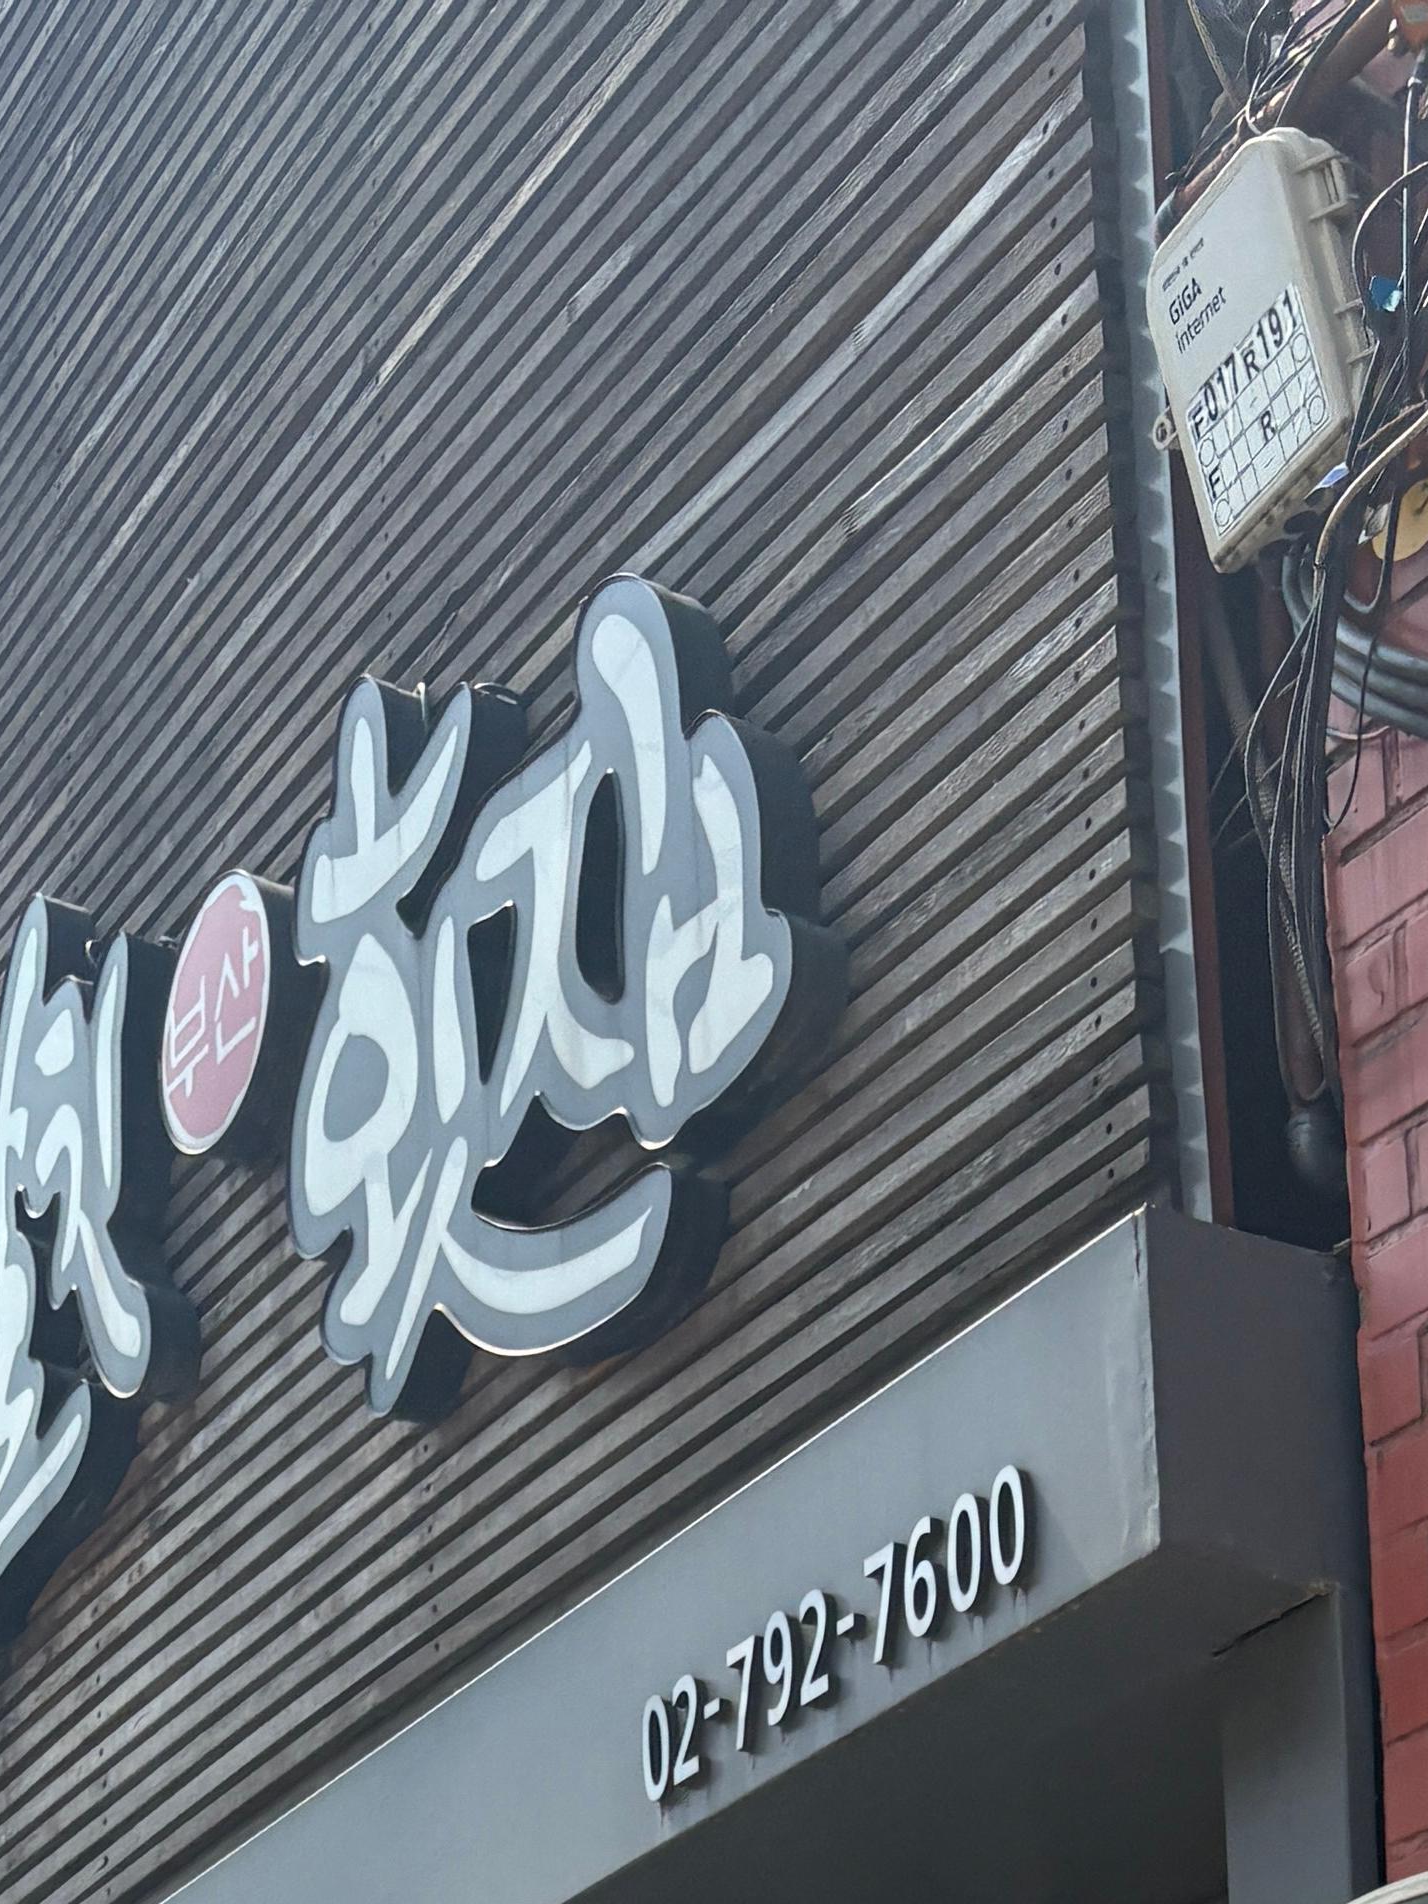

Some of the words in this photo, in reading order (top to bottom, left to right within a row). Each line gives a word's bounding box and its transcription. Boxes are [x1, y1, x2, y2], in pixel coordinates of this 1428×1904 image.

[1169, 278, 1203, 325] GiGA
[1175, 287, 1227, 354] internet
[166, 926, 259, 1098] 부산
[291, 573, 792, 1417] 횟집
[642, 1464, 1025, 1801] 02-792-7600
